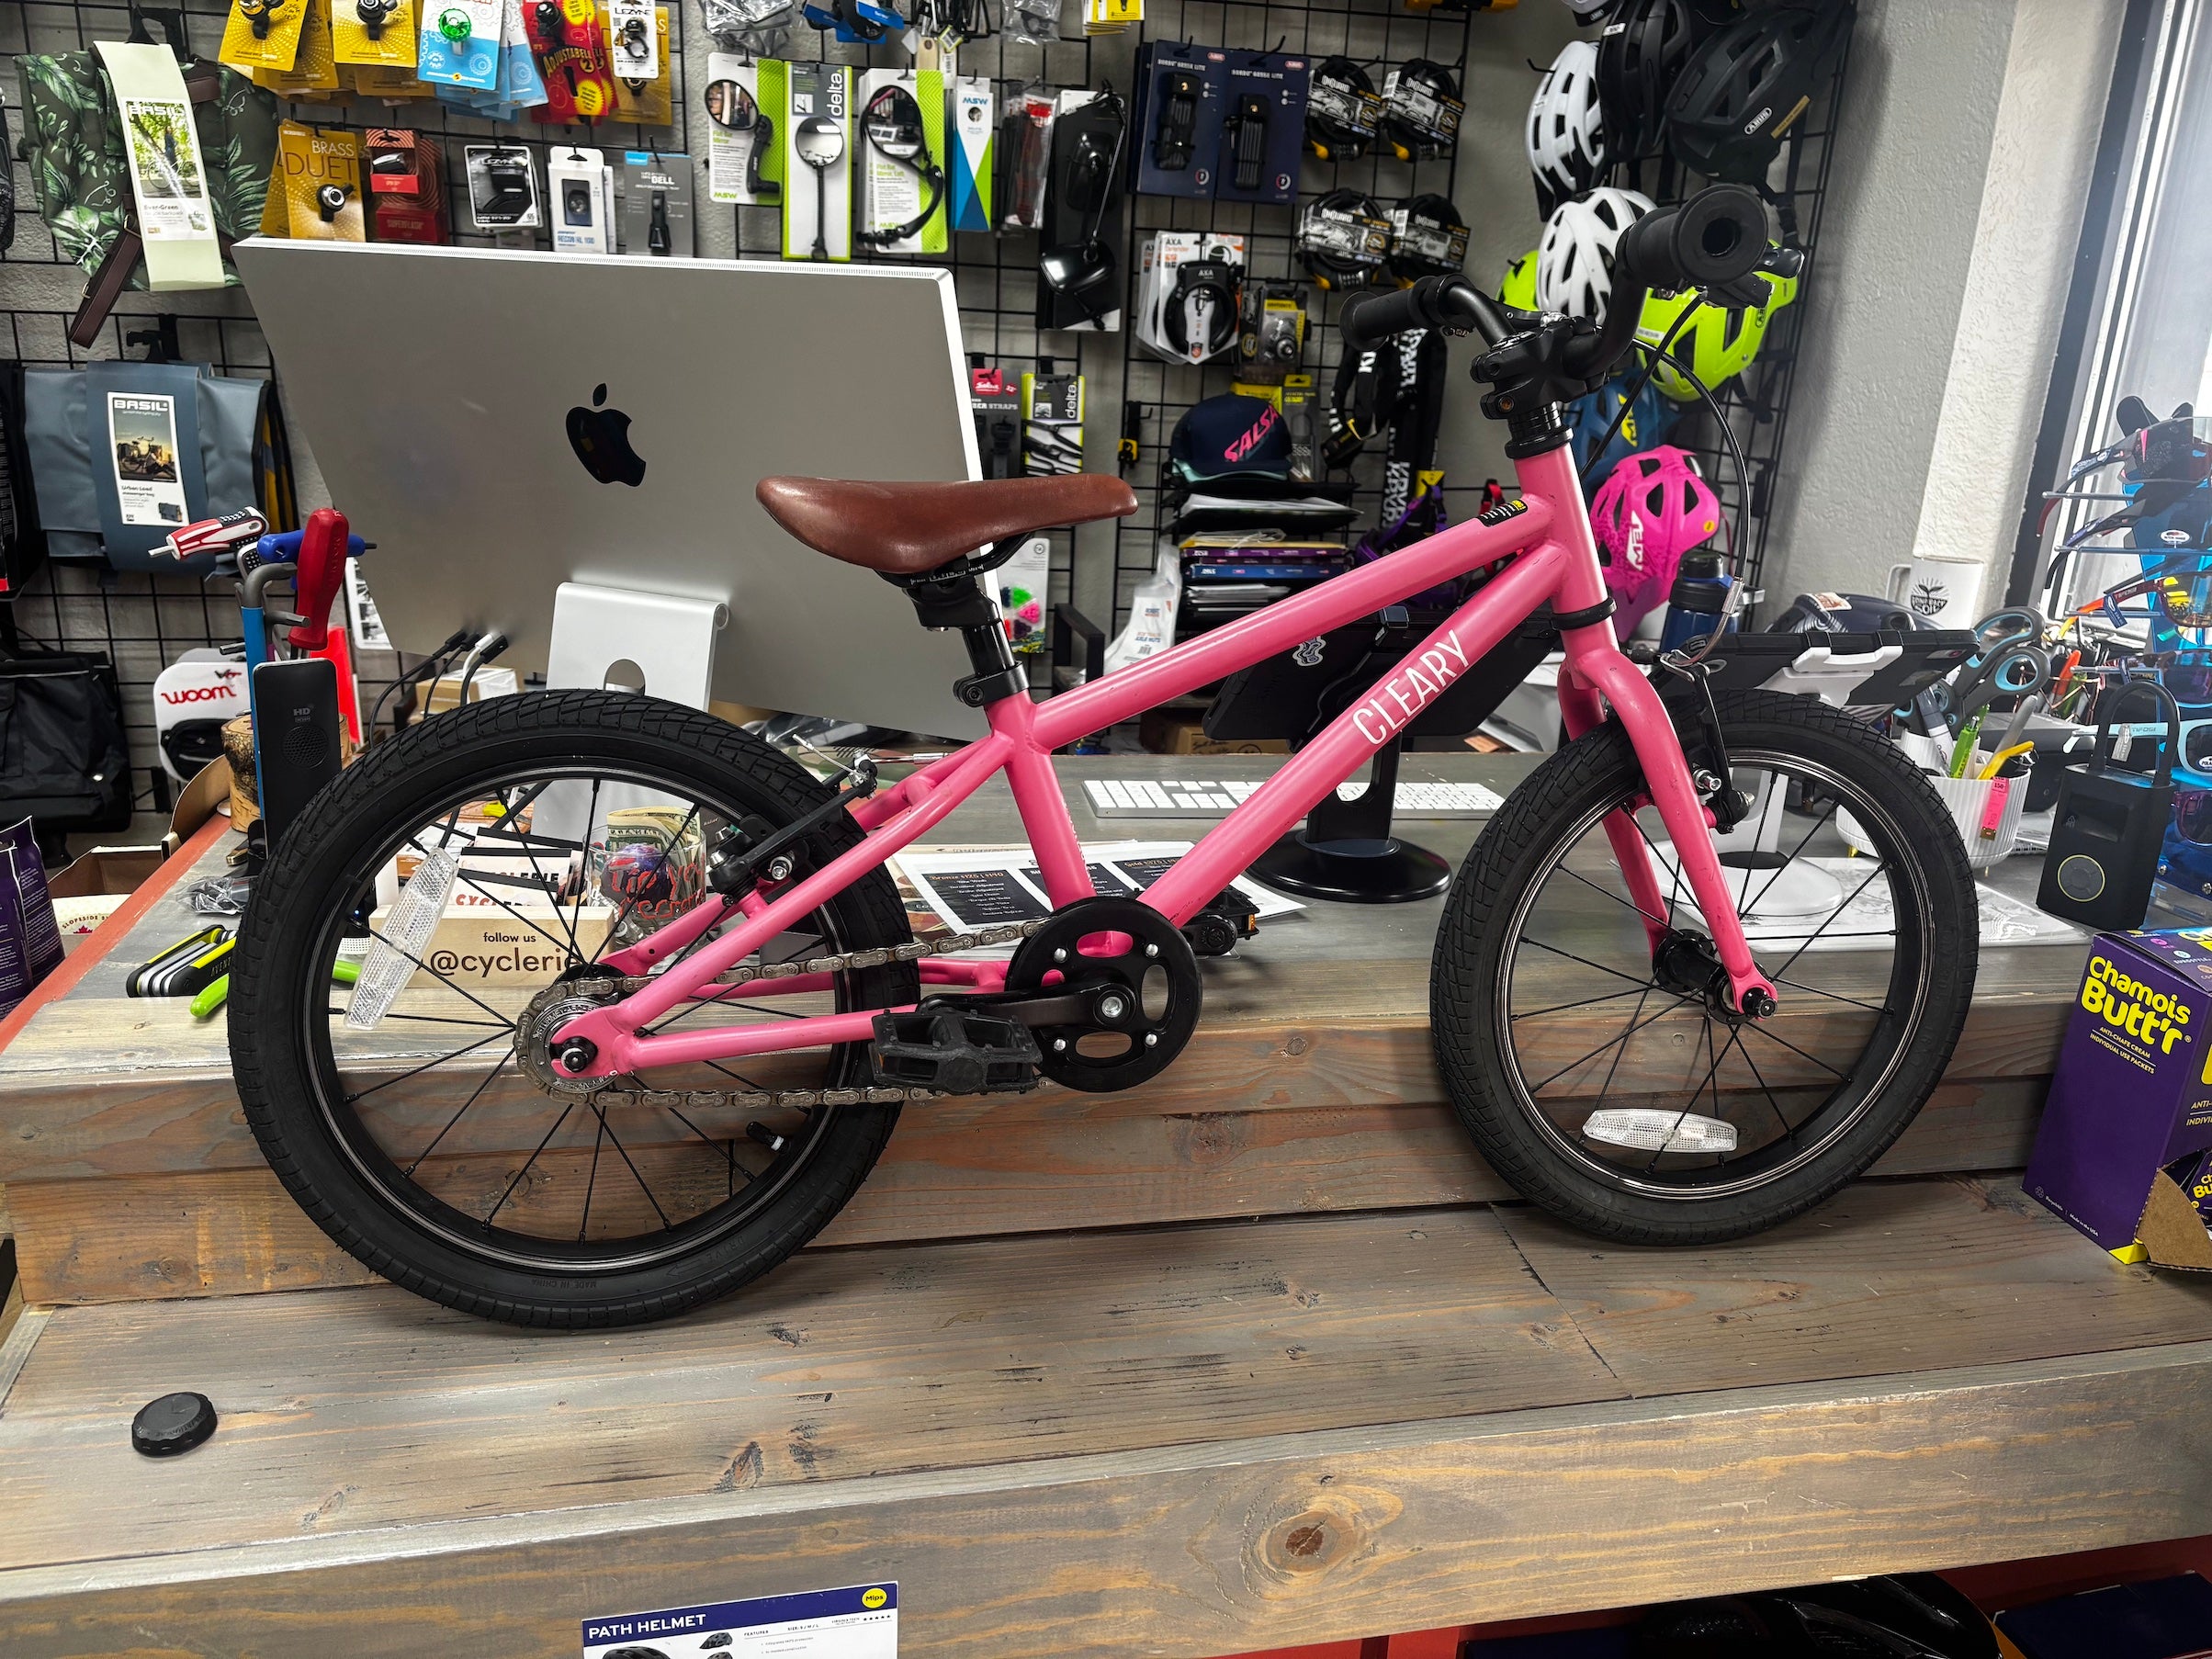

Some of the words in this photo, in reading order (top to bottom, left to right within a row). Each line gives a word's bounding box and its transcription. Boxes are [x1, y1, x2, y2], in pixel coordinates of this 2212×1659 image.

[581, 57, 594, 72] 2
[826, 72, 843, 117] delta
[962, 97, 988, 106] MSW
[311, 140, 355, 156] BRASS
[285, 152, 357, 181] DUET
[1197, 268, 1214, 276] AXA
[113, 399, 168, 412] BASIL
[1064, 384, 1078, 419] delta
[1224, 404, 1280, 463] SALSA
[1626, 510, 1644, 571] MET
[161, 685, 238, 705] woom
[1352, 629, 1470, 746] CLEARY
[293, 707, 310, 717] HD
[608, 858, 658, 894] Tip
[62, 915, 98, 930] SLOPESIDE
[483, 932, 519, 942] follow
[523, 934, 536, 942] us
[2089, 955, 2192, 1024] Chamois
[2081, 976, 2183, 1055] Butt'r
[2099, 1026, 2130, 1047] ANTI-CHAFE
[2130, 1044, 2151, 1059] CREAM
[2090, 1033, 2120, 1054] INDIVIDUAL
[2119, 1050, 2131, 1062] USE
[2130, 1055, 2155, 1075] PACKETS
[531, 1279, 559, 1288] CHINA
[559, 1281, 570, 1289] IN
[575, 1281, 597, 1289] MADE
[865, 1594, 884, 1603] Mips
[589, 1623, 632, 1639] PATH
[638, 1614, 706, 1633] HELMET
